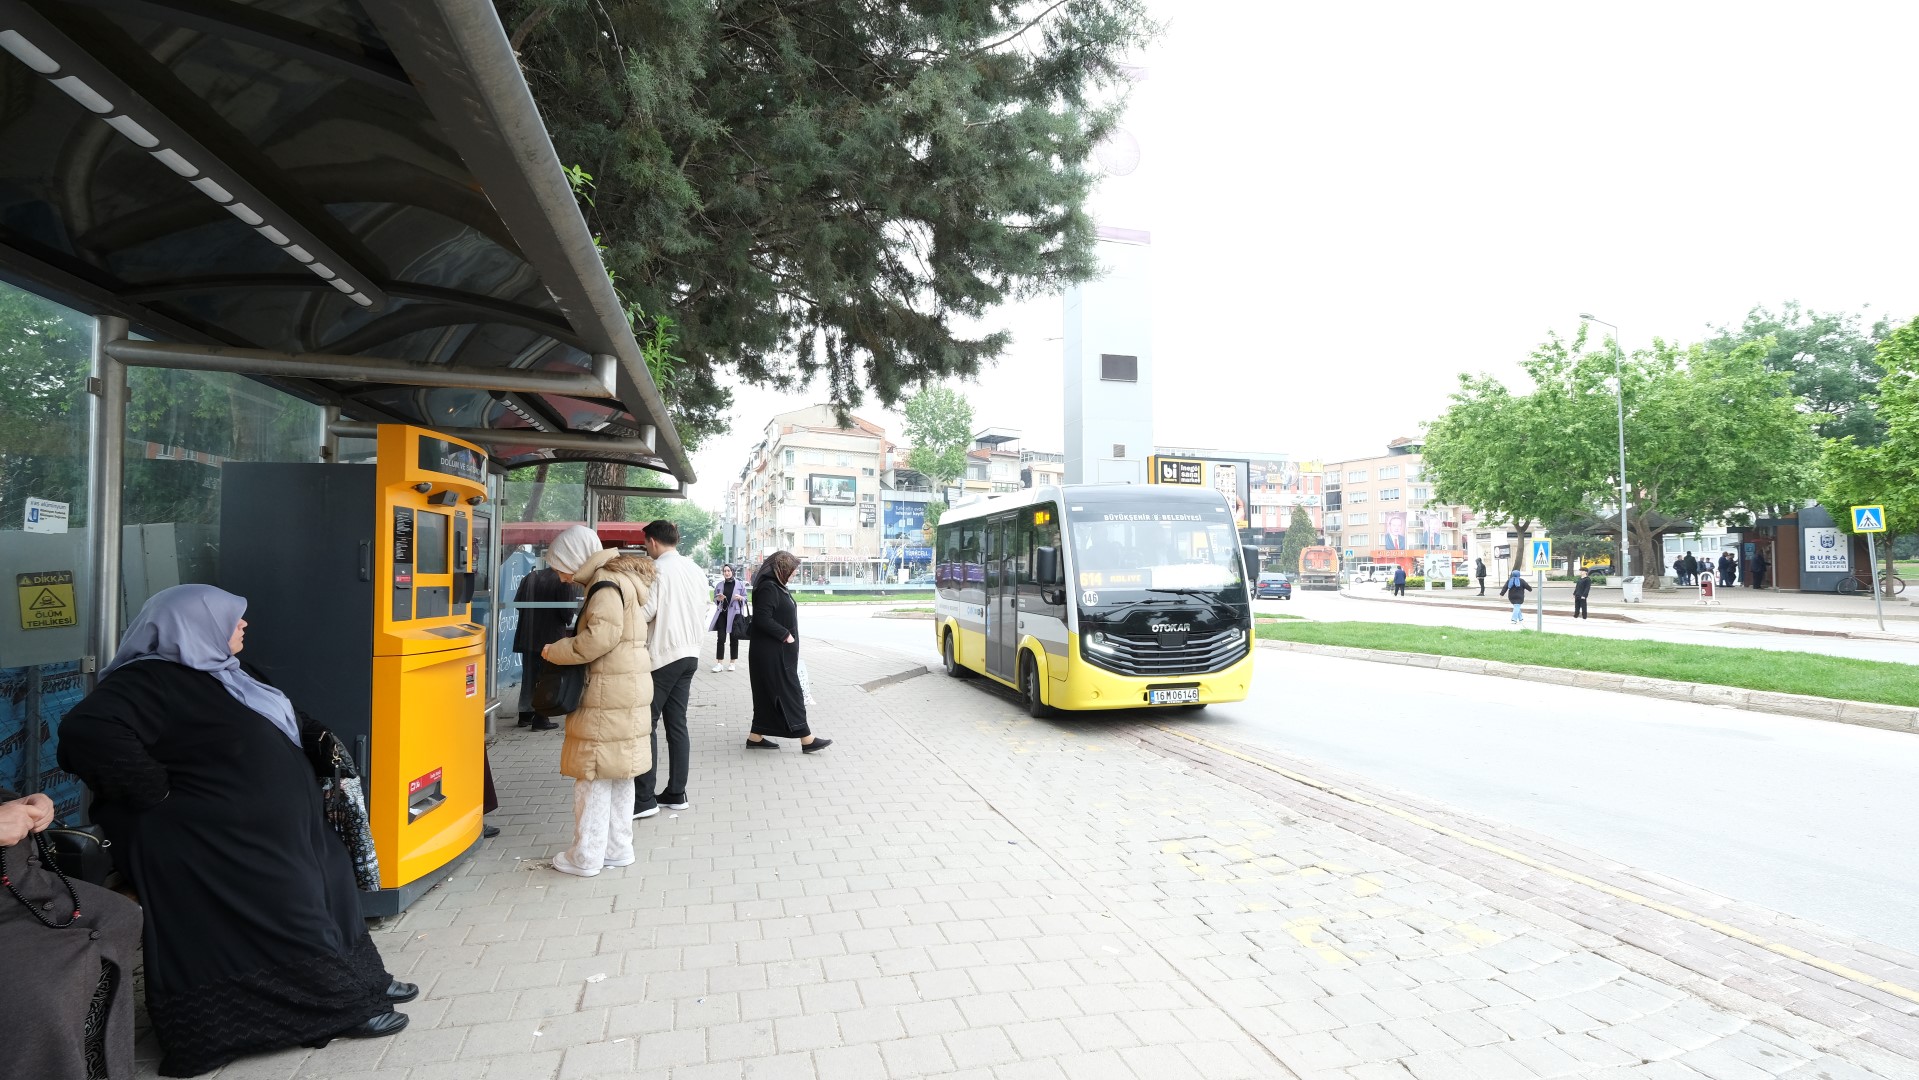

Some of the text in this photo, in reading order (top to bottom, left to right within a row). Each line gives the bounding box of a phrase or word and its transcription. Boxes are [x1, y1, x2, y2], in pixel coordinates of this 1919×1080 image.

[440, 457, 460, 469] DOLUM
[1163, 463, 1177, 479] bi
[1103, 513, 1150, 522] BÜYÜKŞEHİR
[33, 573, 70, 584] DİKKAT
[1083, 593, 1098, 604] 146
[35, 610, 62, 618] ÖLÜM
[27, 616, 73, 627] TEHLİKESİ
[1151, 622, 1191, 633] OTOKAR
